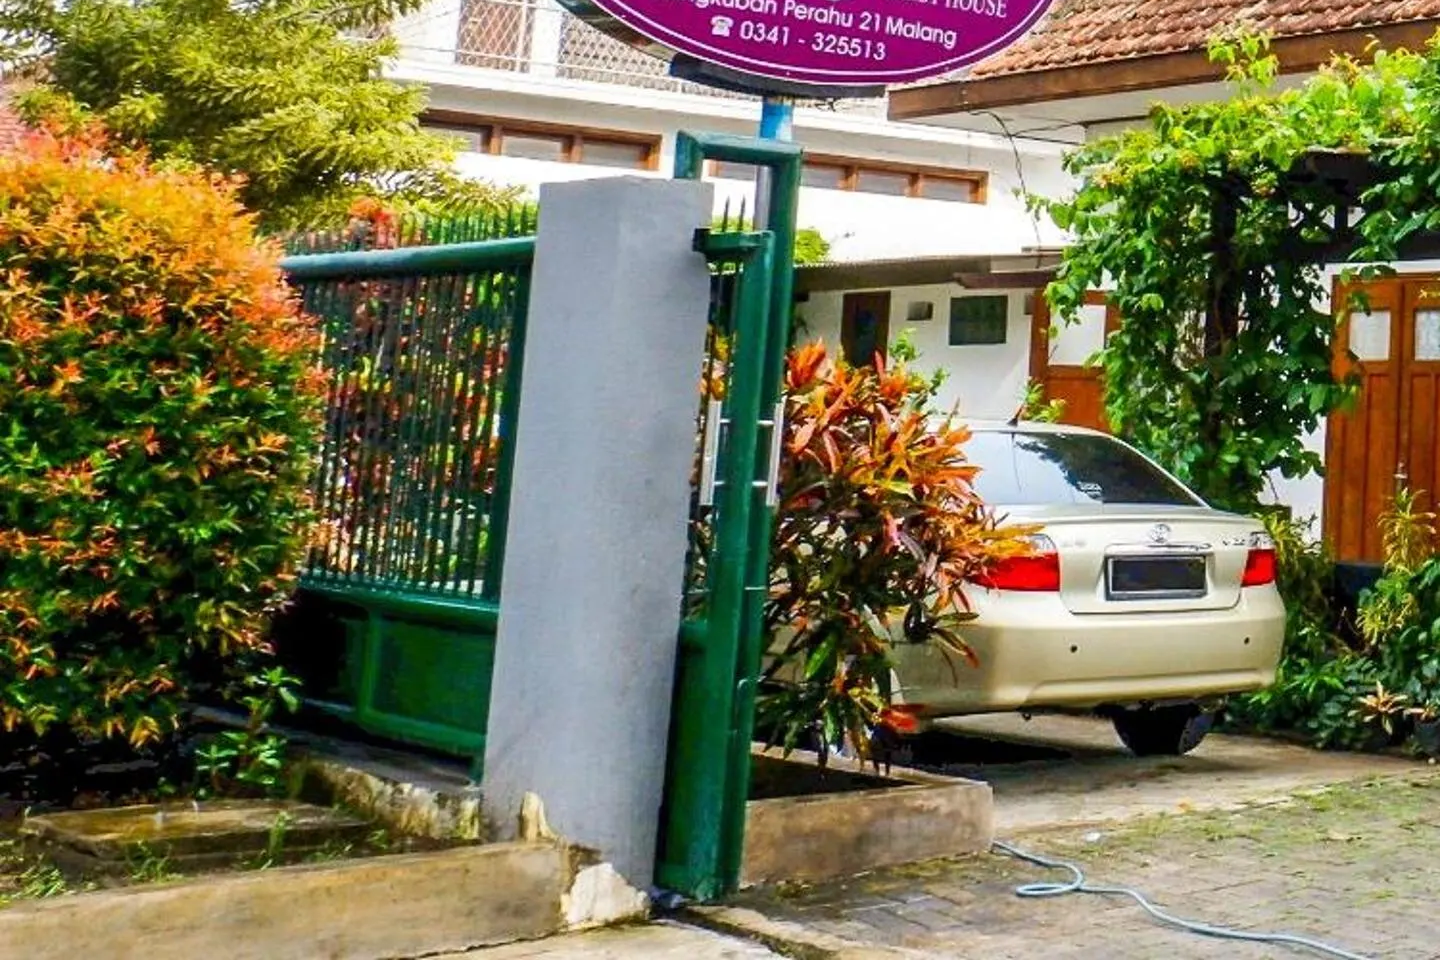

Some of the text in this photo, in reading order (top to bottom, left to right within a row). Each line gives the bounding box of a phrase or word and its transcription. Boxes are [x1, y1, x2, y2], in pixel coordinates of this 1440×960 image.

[740, 21, 789, 46] 0341
[811, 32, 886, 61] 325513
[859, 12, 880, 32] 21
[885, 16, 957, 49] Malang
